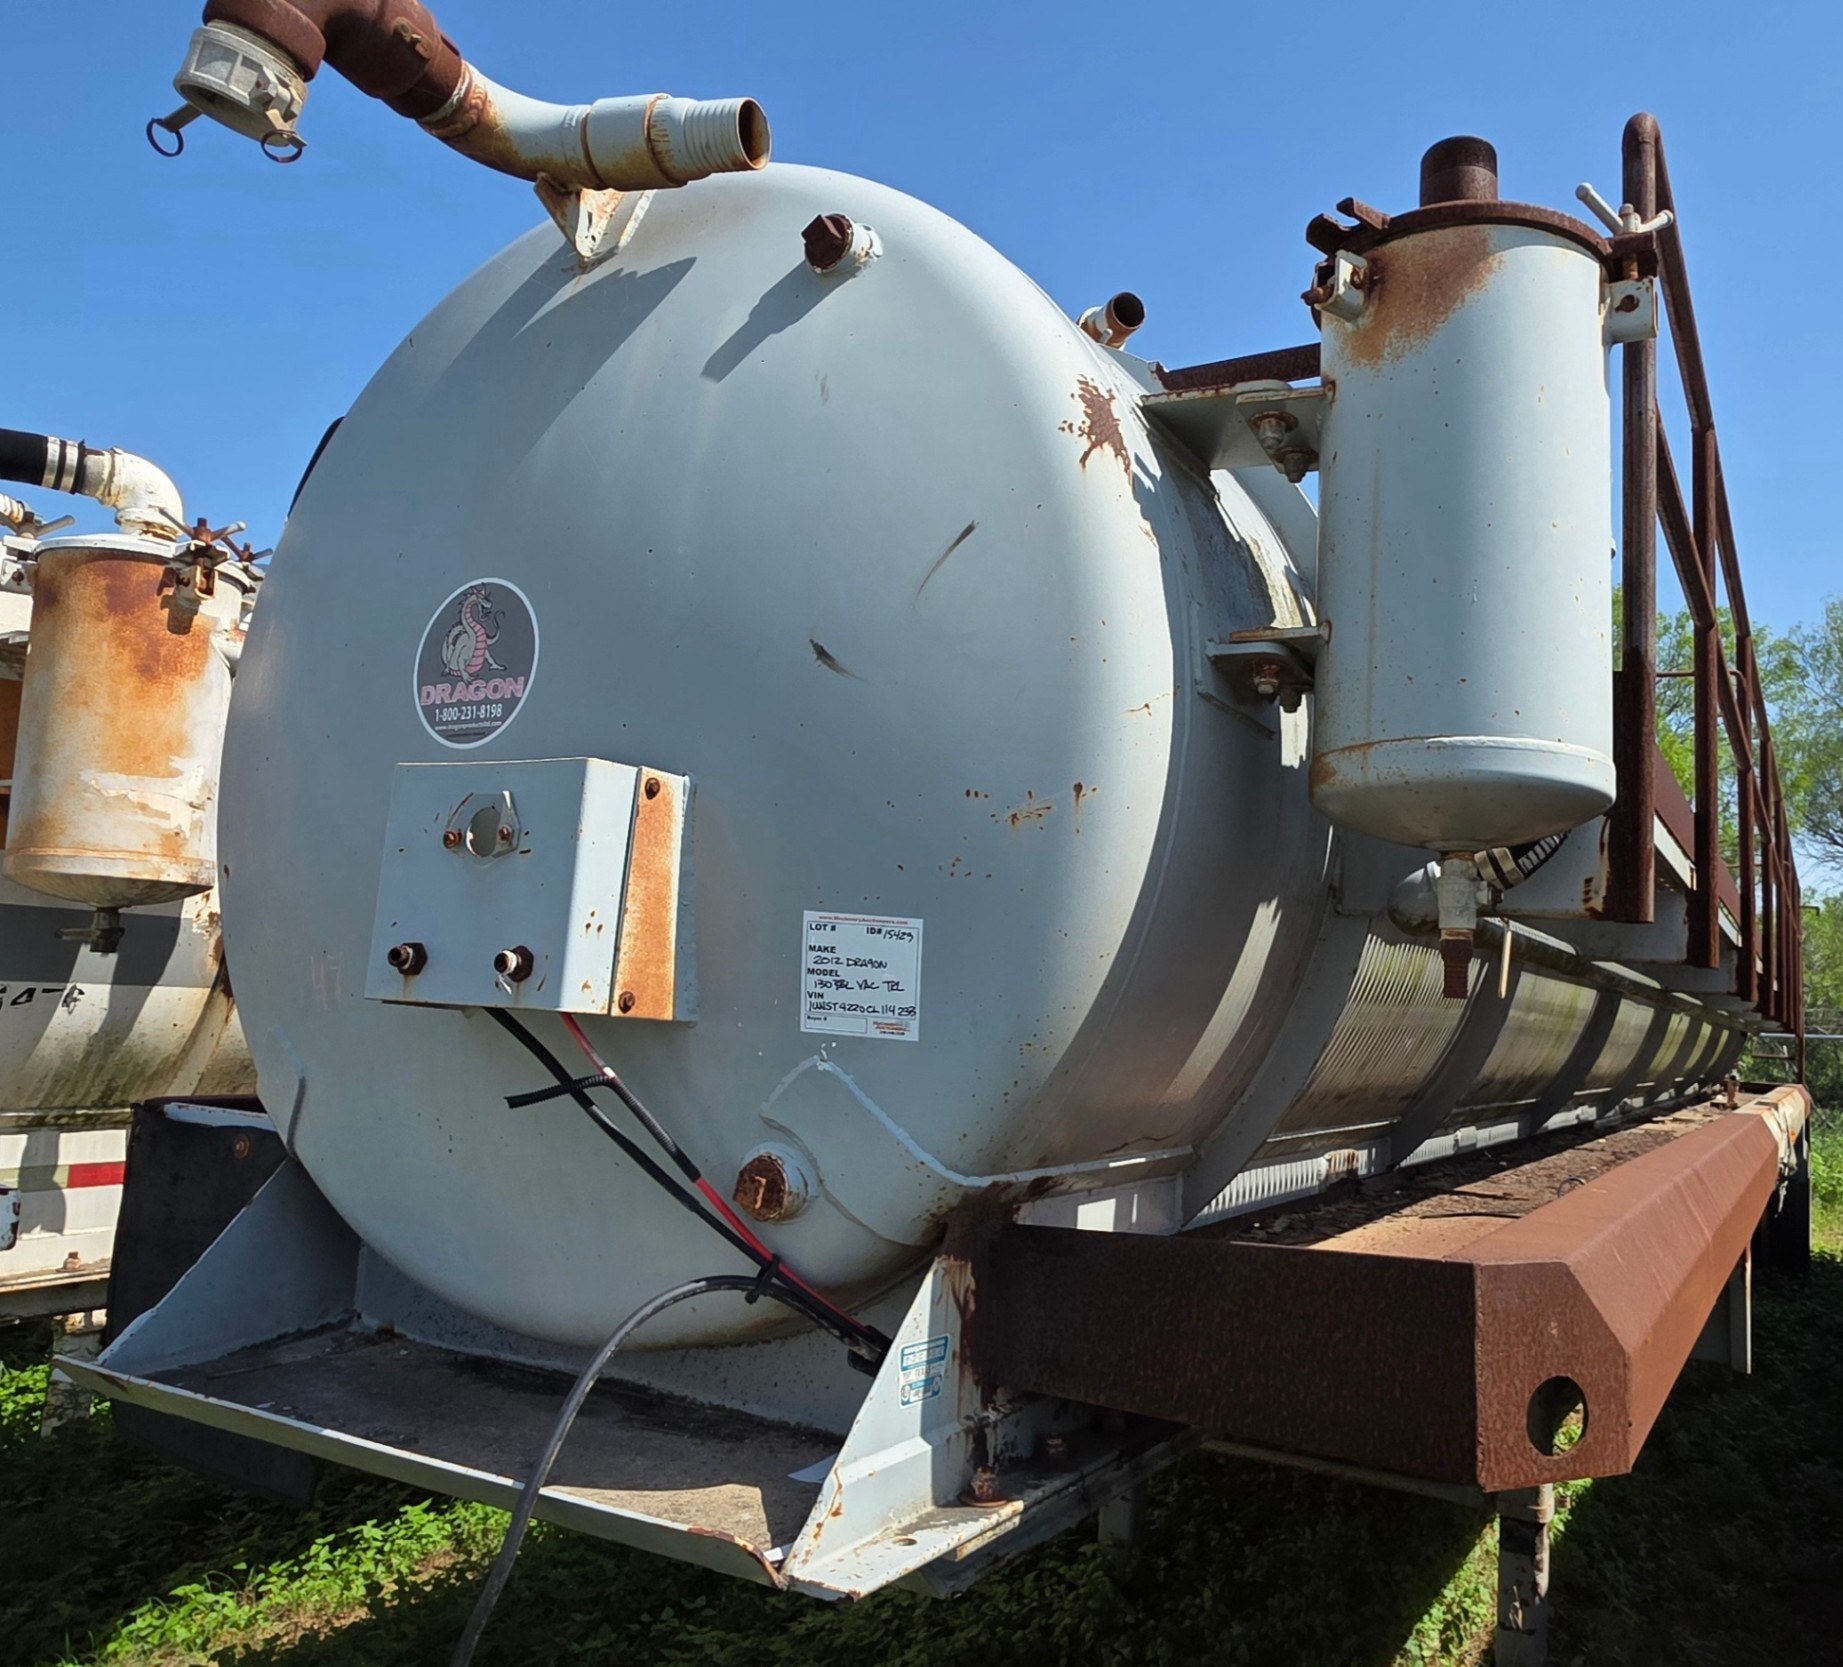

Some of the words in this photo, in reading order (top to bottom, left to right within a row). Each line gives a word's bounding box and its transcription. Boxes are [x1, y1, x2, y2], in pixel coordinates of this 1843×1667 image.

[420, 677, 525, 705] DRAGON
[434, 703, 503, 722] 1-800-231-8198
[809, 923, 828, 932] LOT
[808, 944, 837, 954] MAKE
[812, 955, 844, 966] 2012
[807, 967, 841, 978] MODEL
[806, 991, 825, 999] VIN
